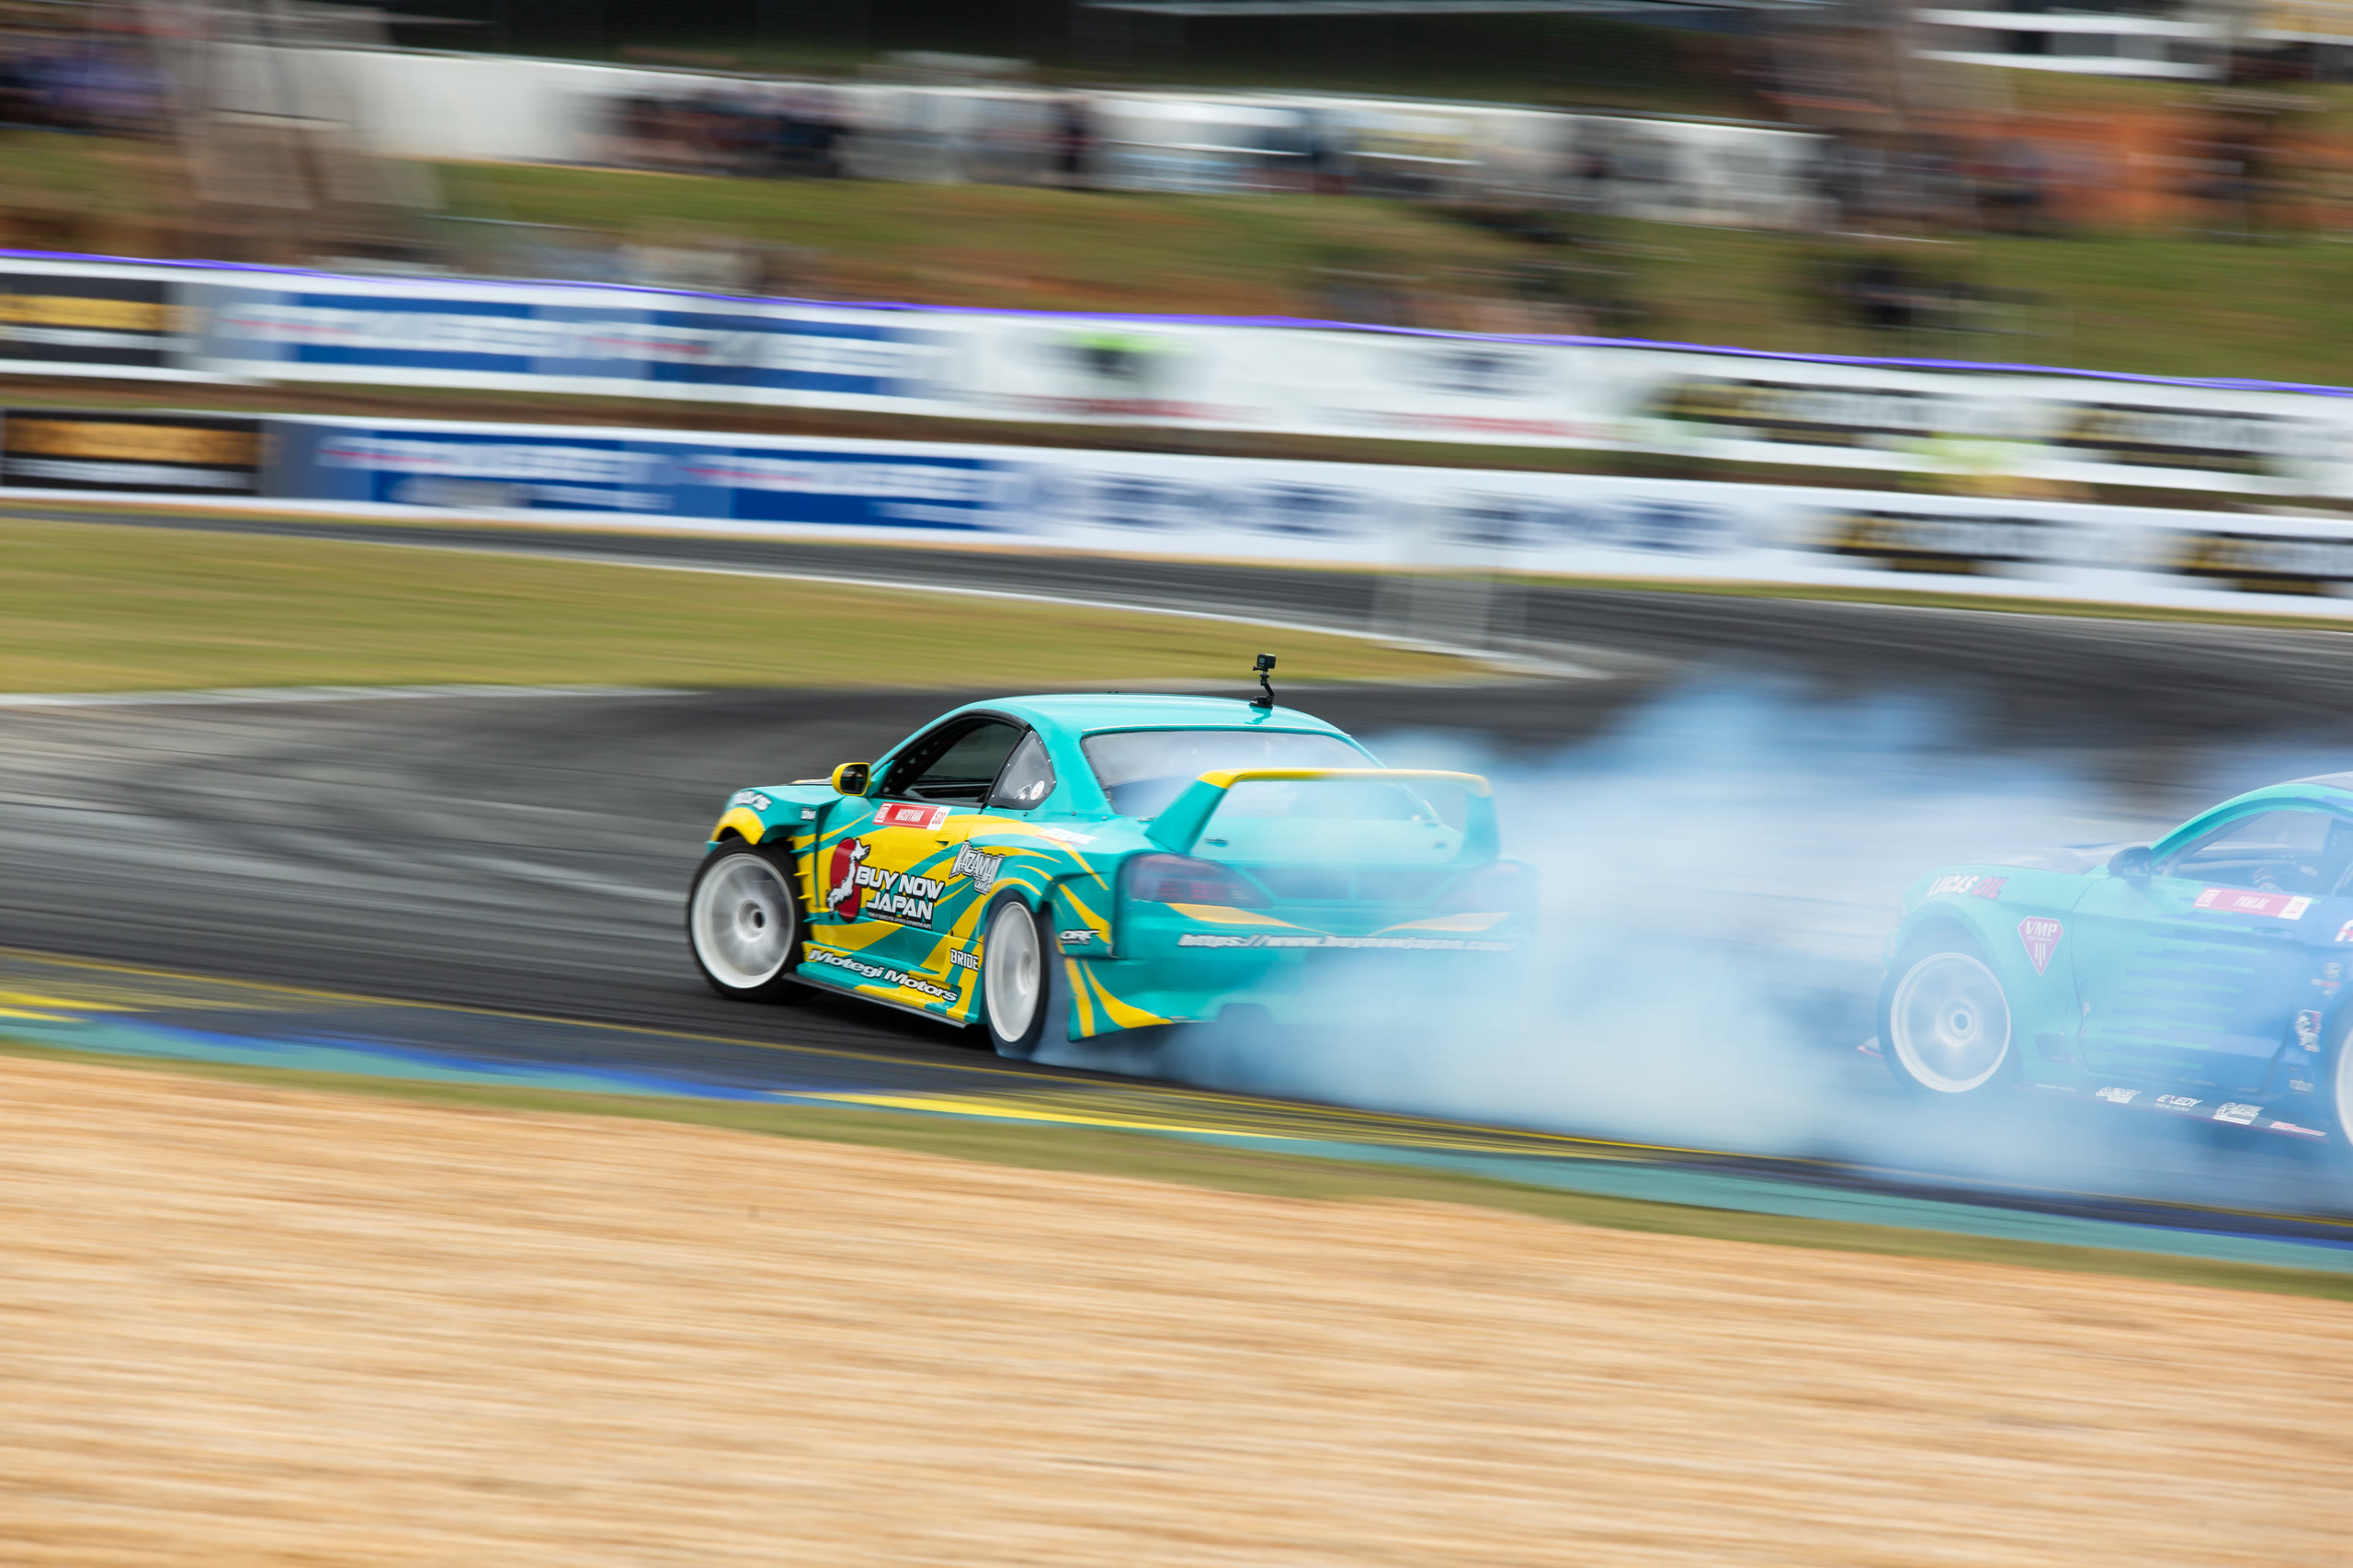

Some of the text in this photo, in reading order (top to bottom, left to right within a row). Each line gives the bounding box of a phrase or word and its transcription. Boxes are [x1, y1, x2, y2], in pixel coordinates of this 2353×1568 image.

[855, 866, 945, 900] BUY NOW
[1927, 875, 2010, 900] LUCAS OIL
[866, 891, 934, 921] JAPAN
[2025, 920, 2059, 937] VMP
[949, 949, 980, 971] BRIDE
[807, 949, 959, 1002] Motegi Motors
[2156, 1094, 2203, 1108] EXEDY
